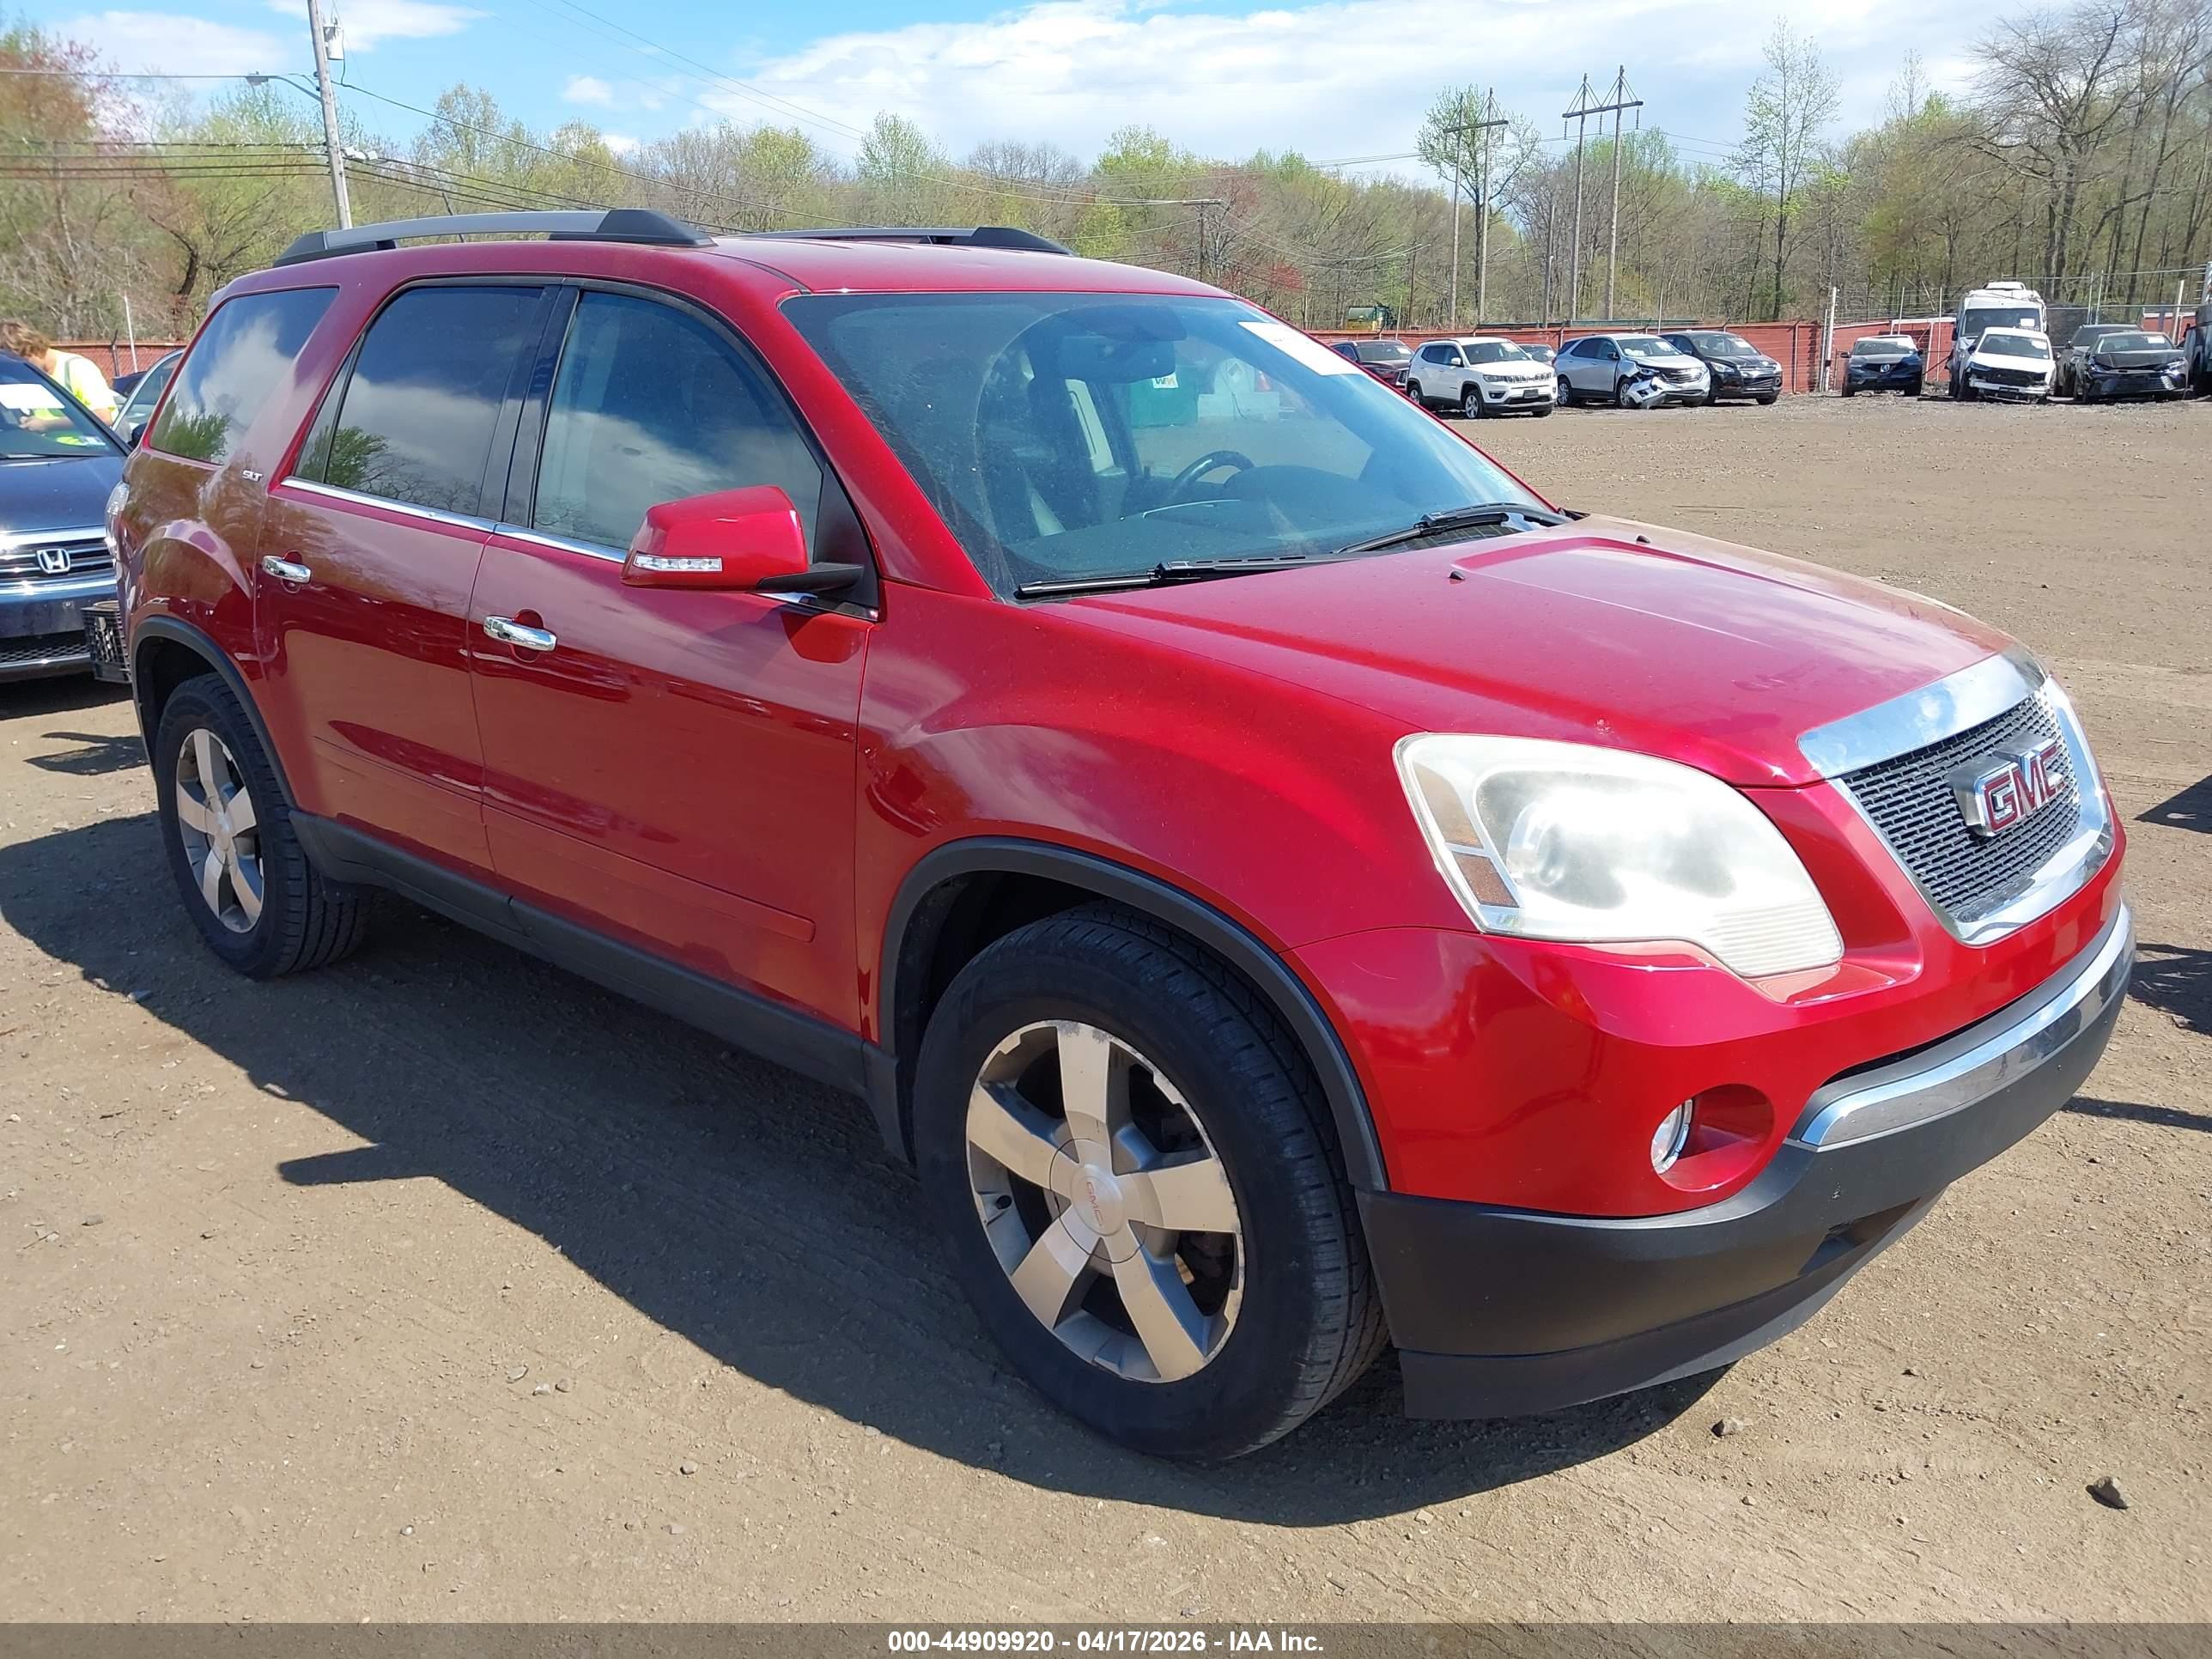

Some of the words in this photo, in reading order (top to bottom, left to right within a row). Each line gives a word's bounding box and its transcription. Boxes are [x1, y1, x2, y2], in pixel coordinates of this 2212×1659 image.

[241, 470, 263, 481] SLT
[1974, 738, 2066, 836] GMC
[1085, 1182, 1103, 1227] GMC
